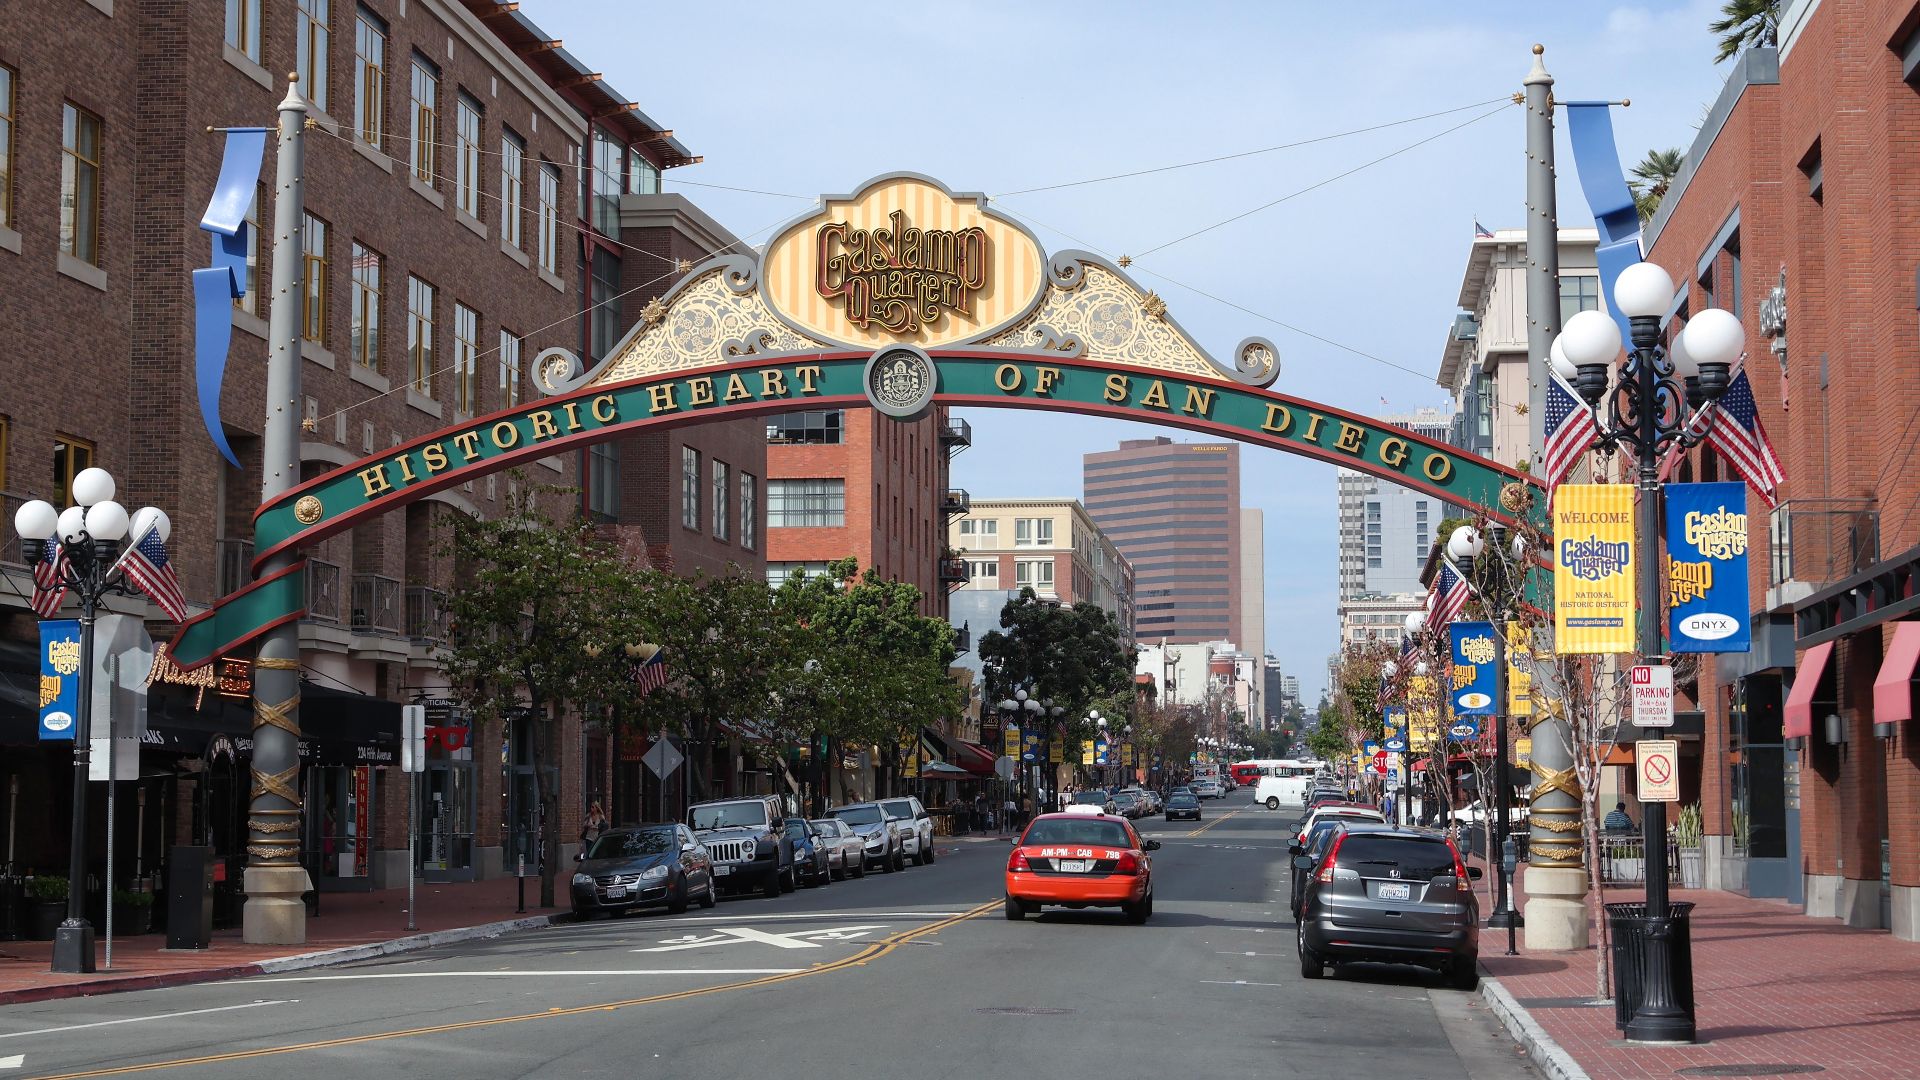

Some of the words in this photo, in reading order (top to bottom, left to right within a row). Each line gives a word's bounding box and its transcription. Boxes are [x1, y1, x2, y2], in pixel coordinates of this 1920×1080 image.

[816, 209, 986, 317] Gaslamp
[845, 271, 962, 333] Quarter
[357, 395, 617, 497] HISTORIC
[645, 366, 821, 413] HEART
[994, 364, 1060, 394] OF
[1103, 373, 1216, 415] SAN
[1260, 402, 1452, 482] DIEGO
[1560, 511, 1630, 524] WELCOME
[1698, 531, 1748, 560] Quarte
[1561, 534, 1630, 574] Gaslamp
[1572, 556, 1619, 581] Quarter
[1575, 591, 1614, 599] NATIONAL
[1567, 618, 1623, 626] www.gaslamp.org
[1691, 621, 1727, 629] ONYX
[1634, 668, 1649, 682] NO
[1636, 687, 1670, 698] PARKING
[1638, 707, 1668, 715] THURSDAY
[377, 747, 392, 761] Avenue
[1195, 769, 1217, 777] FedEx
[1041, 848, 1068, 857] AM-PM
[1076, 848, 1093, 857] CAB
[1105, 850, 1120, 859] 798
